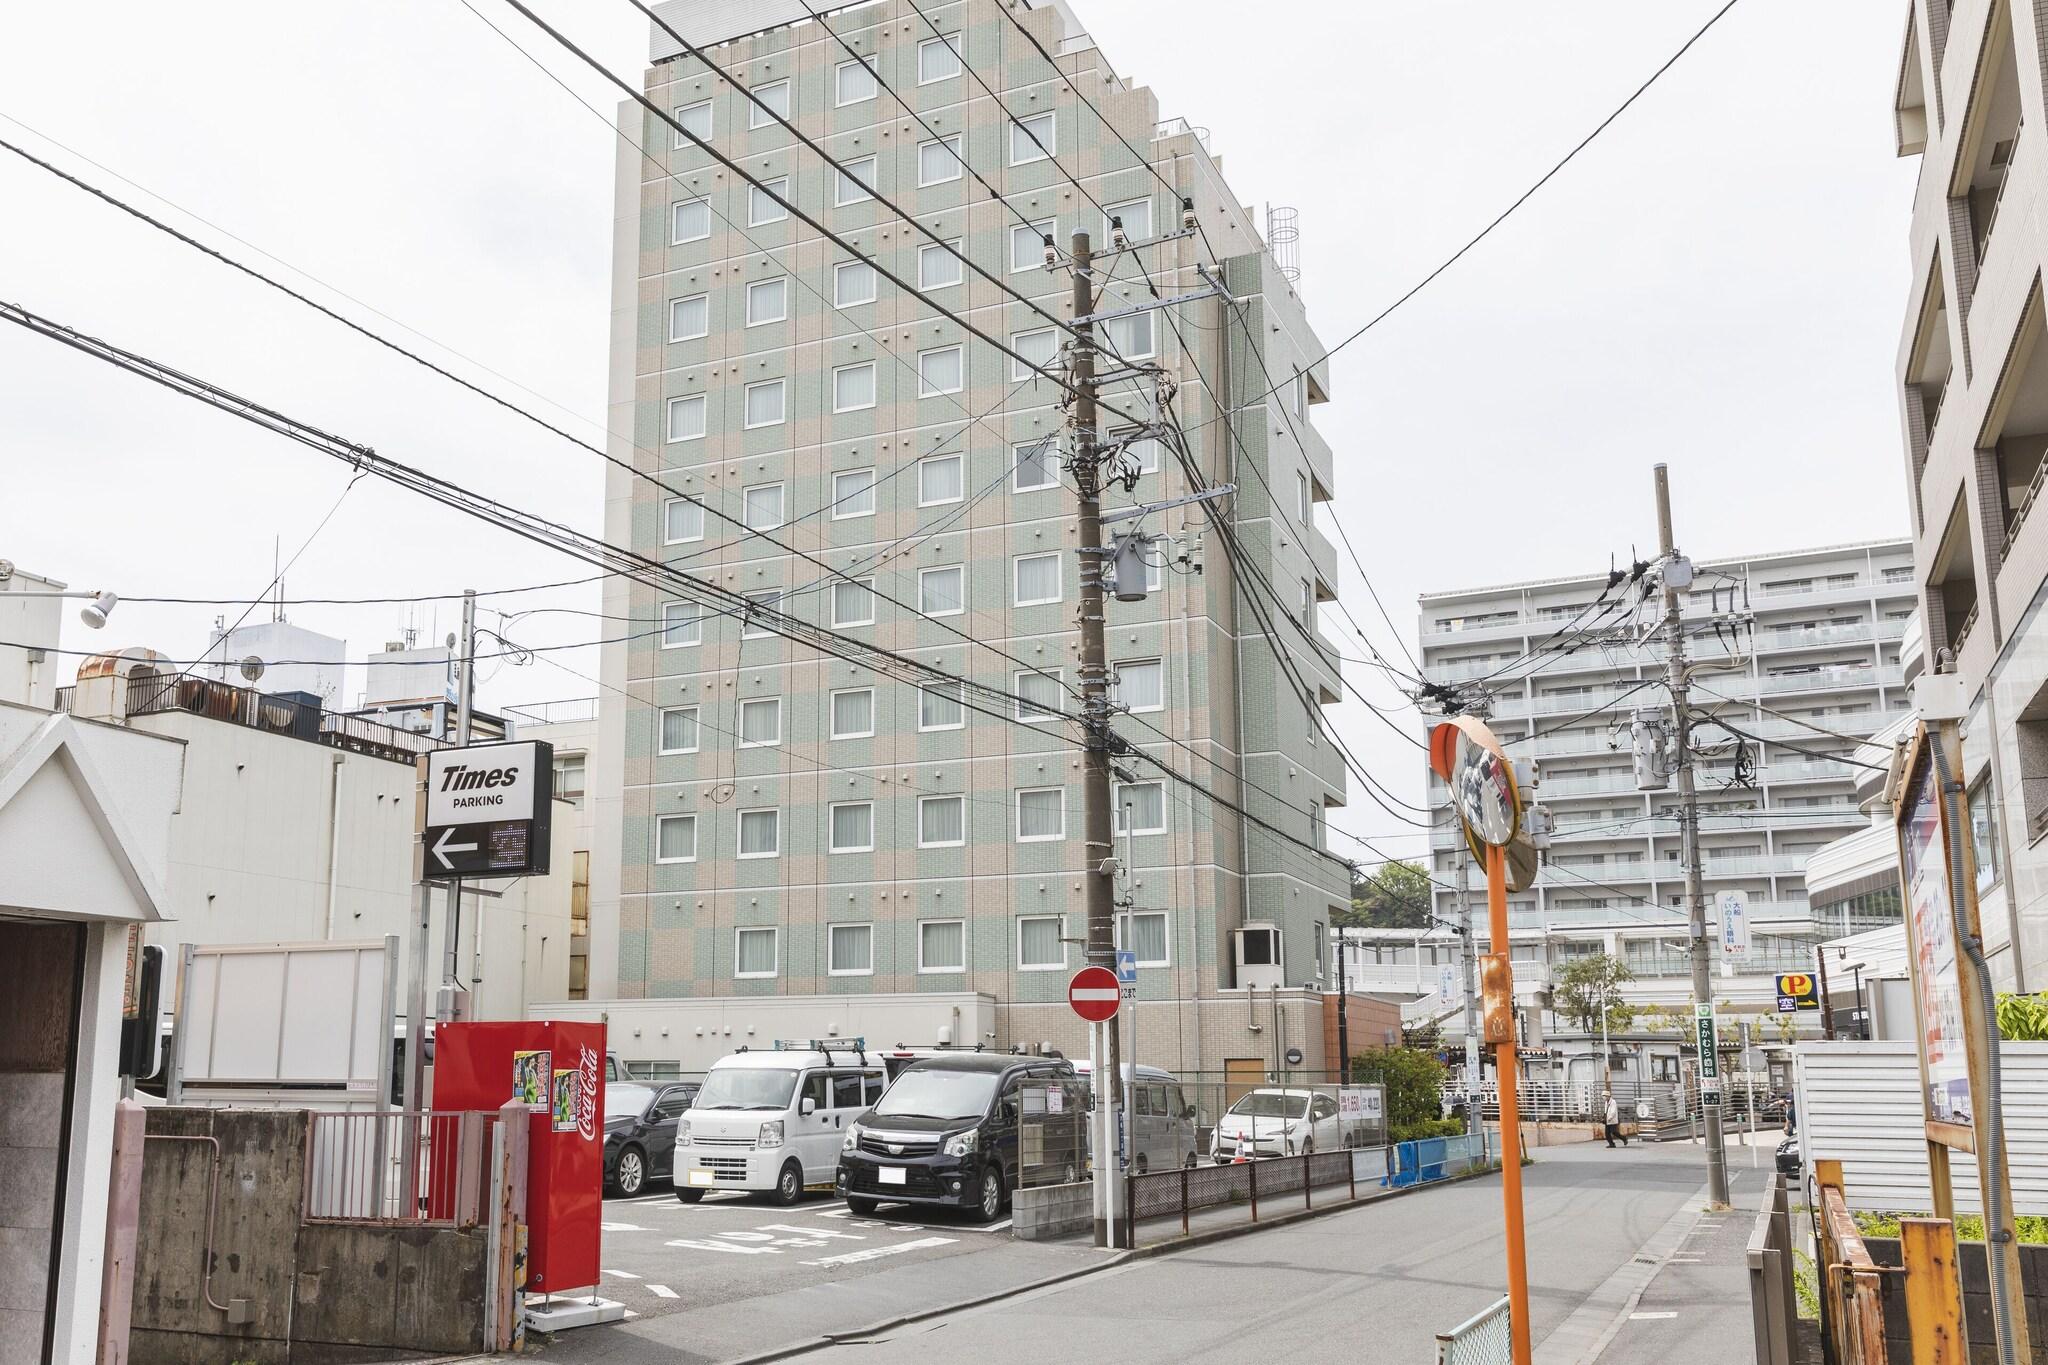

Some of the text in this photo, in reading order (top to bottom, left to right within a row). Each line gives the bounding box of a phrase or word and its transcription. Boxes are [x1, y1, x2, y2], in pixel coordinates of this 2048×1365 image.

[441, 765, 519, 792] Times
[453, 794, 504, 808] PARKING
[491, 825, 526, 868] 空
[1785, 976, 1807, 994] P
[1701, 1019, 1714, 1077] さかむら歯科
